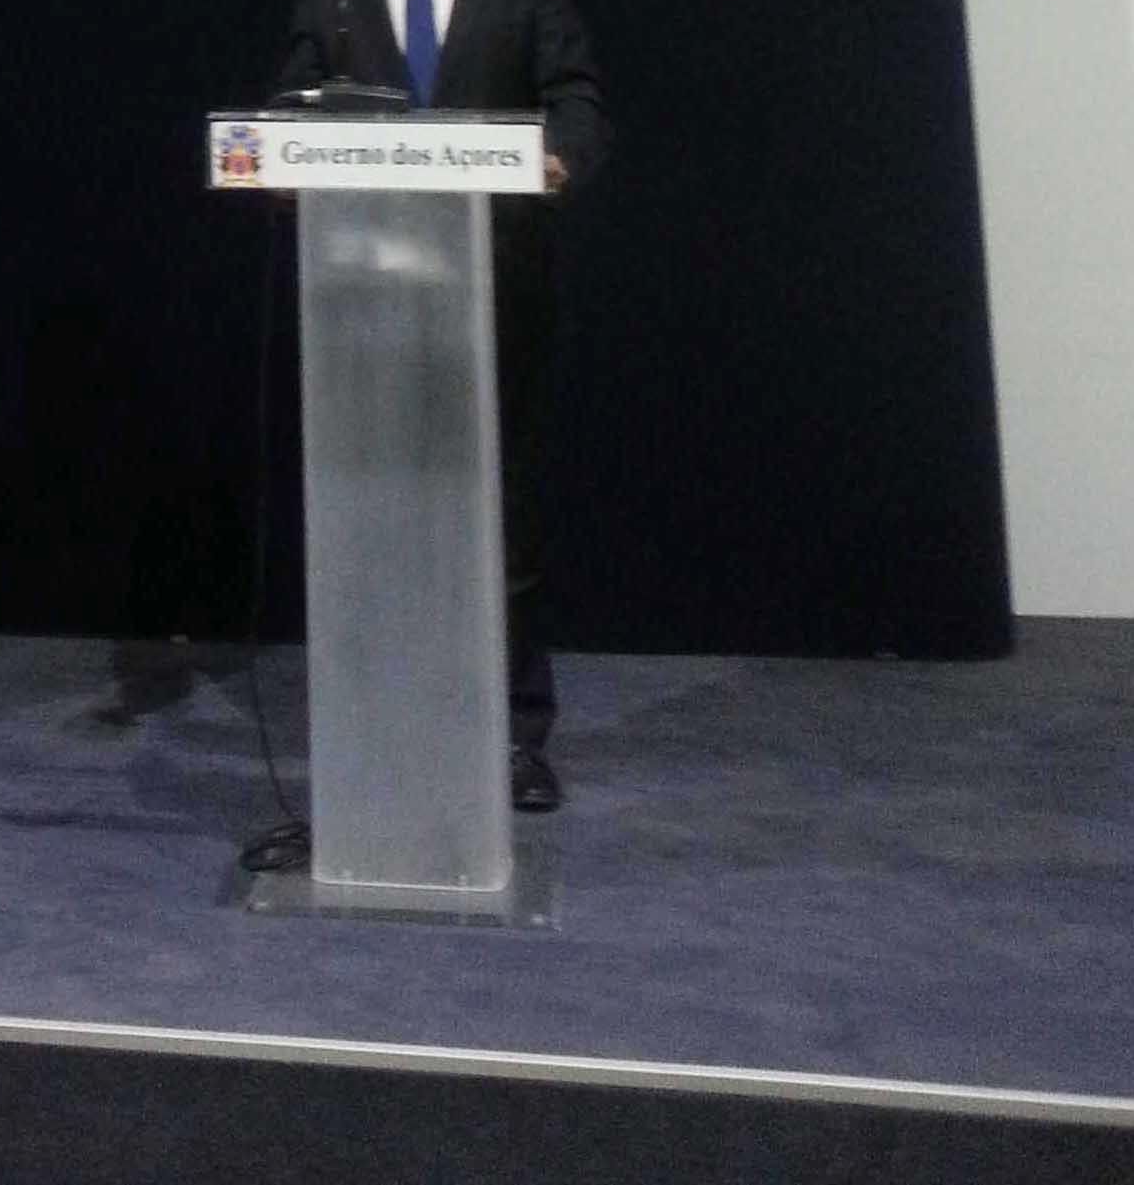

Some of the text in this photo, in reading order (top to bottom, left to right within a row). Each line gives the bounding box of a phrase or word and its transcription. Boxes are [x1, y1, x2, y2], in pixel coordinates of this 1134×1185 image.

[281, 140, 523, 172] Governo dos Açores
